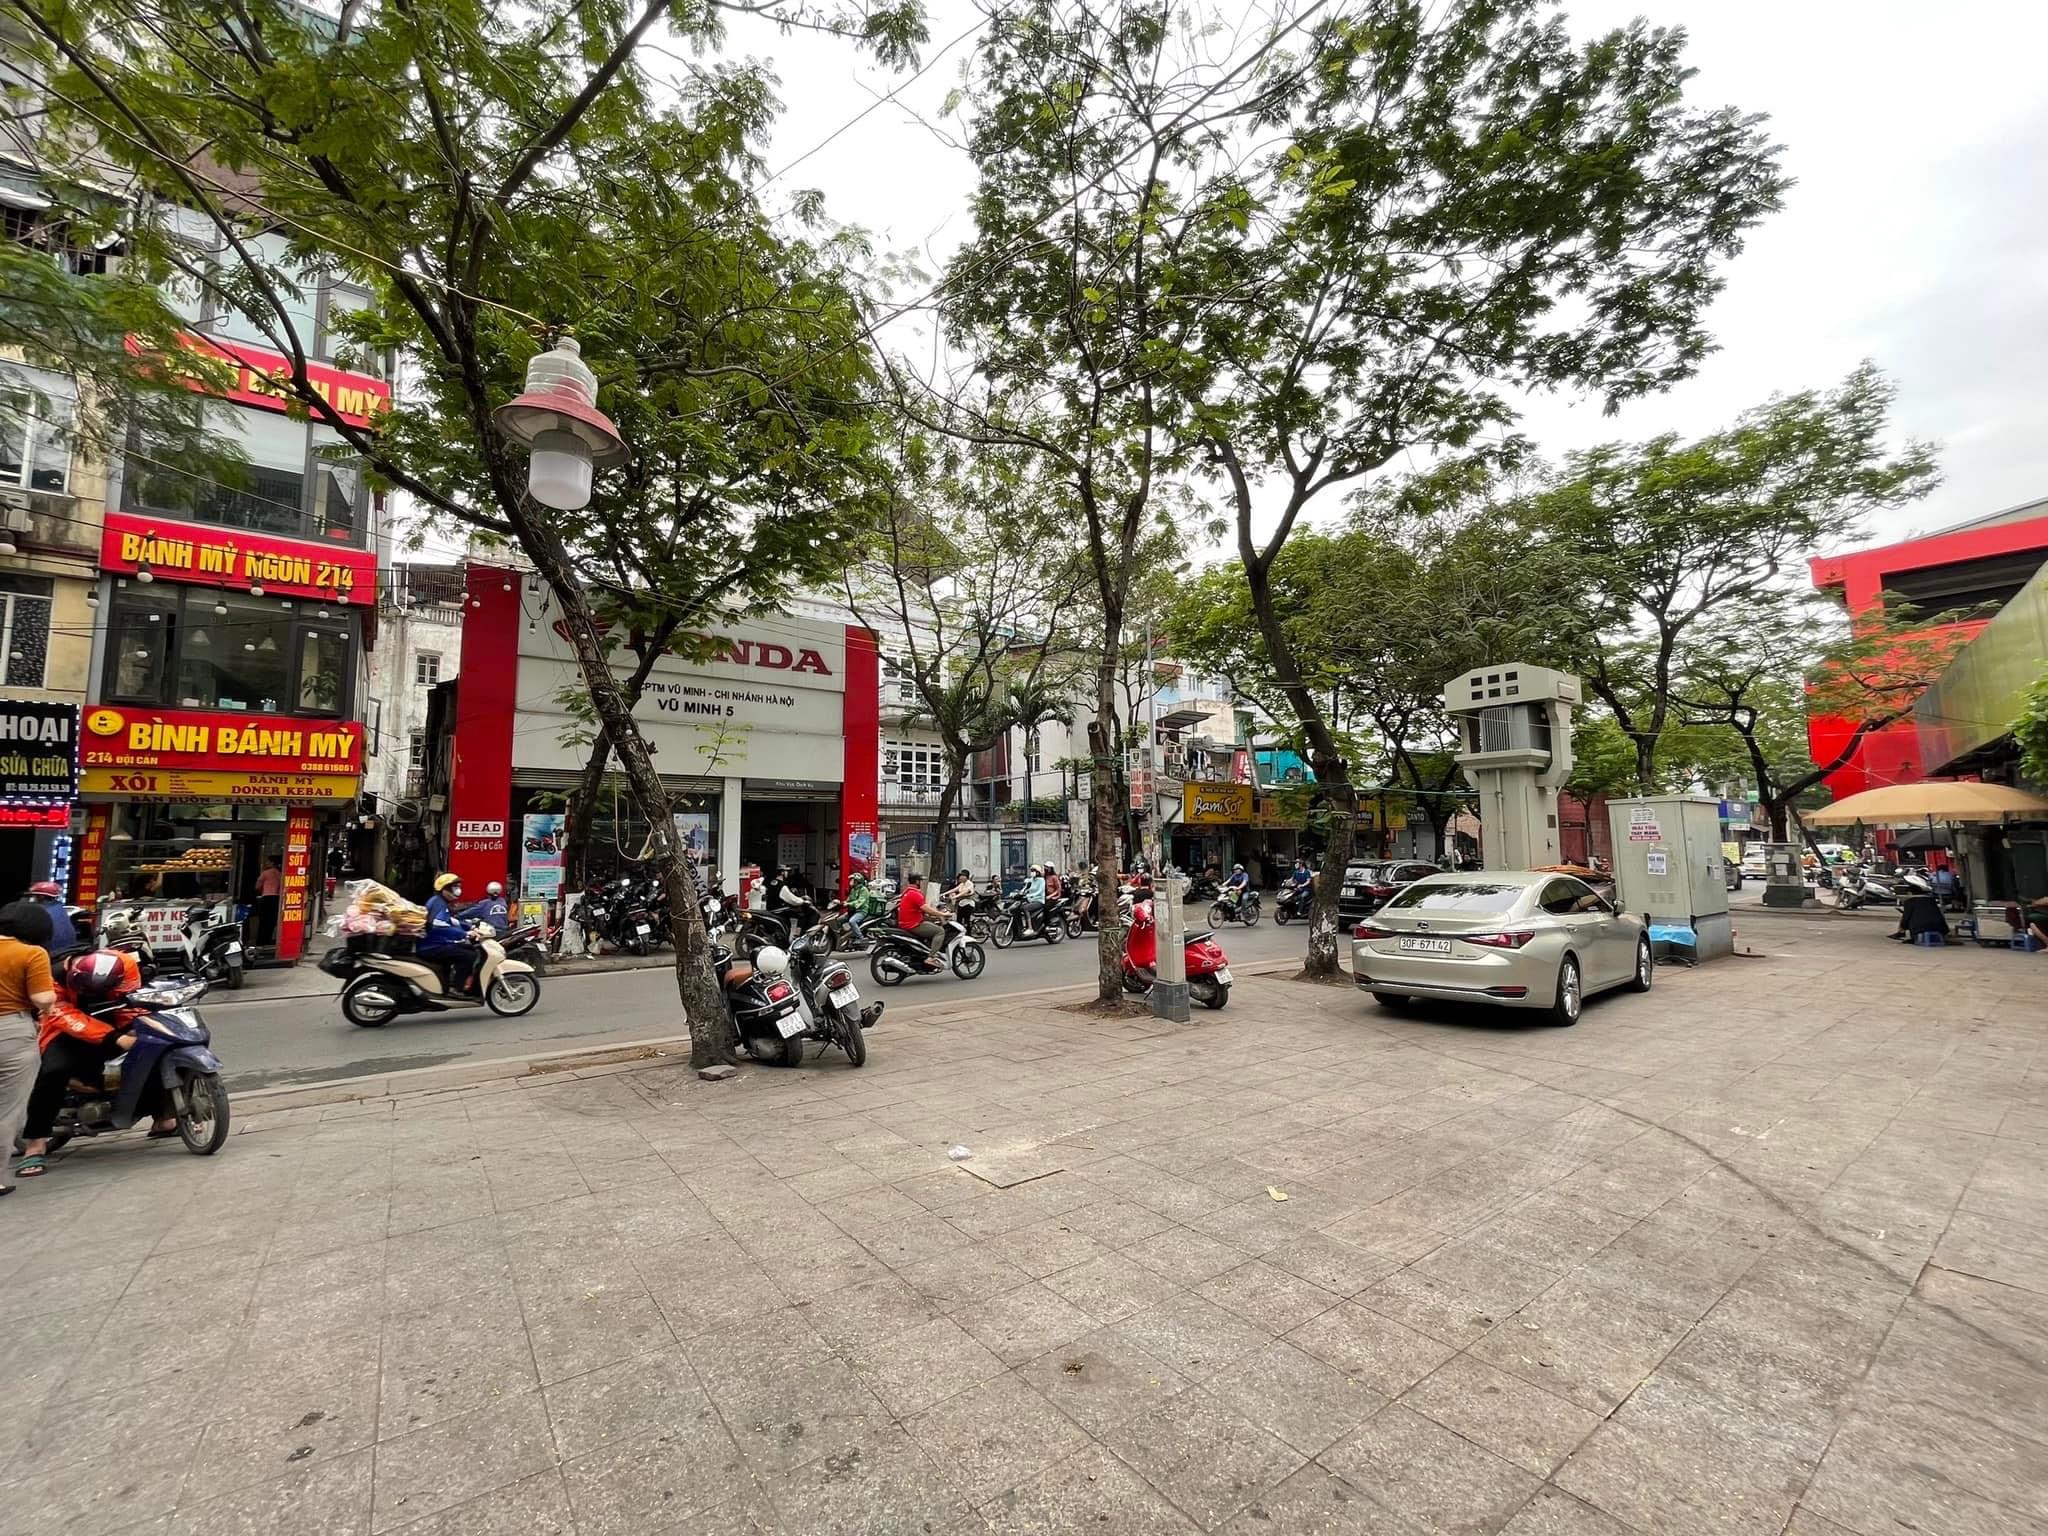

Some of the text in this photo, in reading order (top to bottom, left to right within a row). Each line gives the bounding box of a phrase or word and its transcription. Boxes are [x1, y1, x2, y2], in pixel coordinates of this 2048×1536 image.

[121, 529, 192, 569] BÁNH
[199, 540, 239, 575] MỲ
[316, 561, 354, 590] 214
[668, 683, 681, 694] VŨ
[683, 686, 706, 697] MINH
[714, 689, 730, 699] CHI
[732, 691, 763, 703] NHÁNH
[766, 694, 778, 705] HÀ
[780, 696, 795, 708] NỘI
[658, 698, 734, 716] VŨ MINH 5
[129, 717, 355, 759] BÌNH BÁNH MỲ
[0, 750, 69, 777] SỬA CHỮA
[86, 752, 113, 763] 214
[109, 771, 158, 791] XÔI
[249, 774, 288, 785] BÁNH
[231, 786, 333, 796] DONER KEBAB
[459, 823, 502, 832] HEAD
